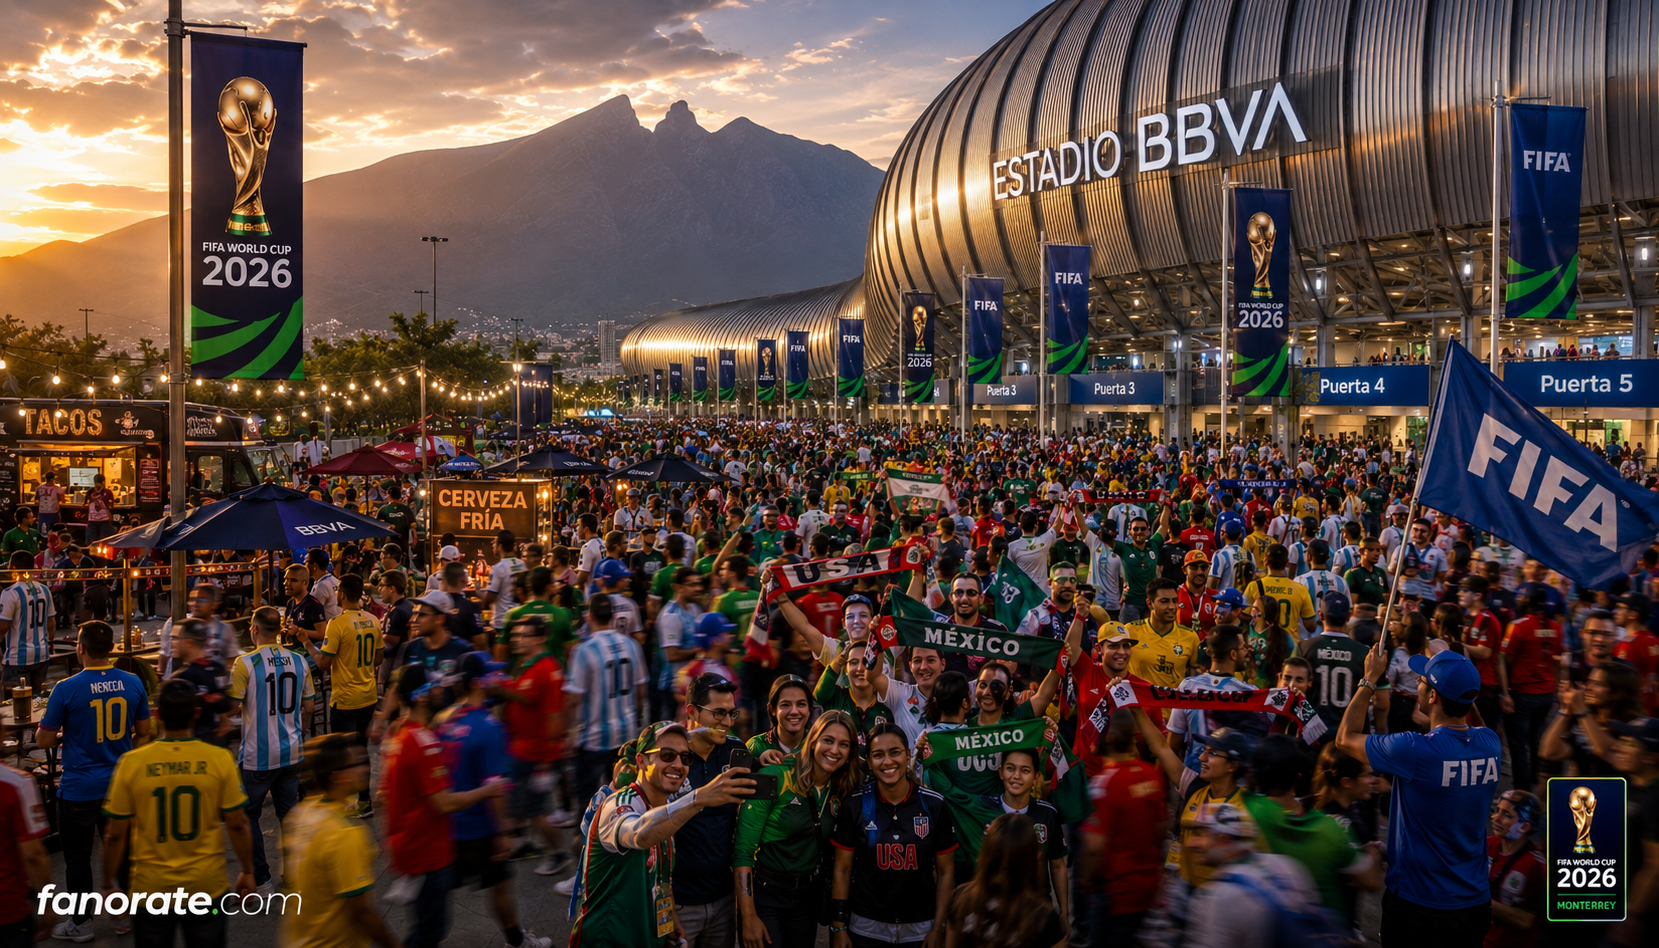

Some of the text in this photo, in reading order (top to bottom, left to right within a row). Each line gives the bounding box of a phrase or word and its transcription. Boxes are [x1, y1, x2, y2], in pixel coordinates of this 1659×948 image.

[992, 82, 1311, 200] ESTADIO BBVA
[1523, 150, 1571, 172] FIFA
[203, 242, 292, 255] FIFA WORLD CUP
[202, 255, 293, 289] 2026
[1055, 272, 1083, 285] FIFA
[974, 300, 998, 311] FIFA
[1238, 310, 1284, 328] 2026
[843, 335, 860, 343] FIFA
[907, 358, 932, 367] 2026
[1010, 385, 1017, 396] 3
[1094, 382, 1135, 395] Puerta 3
[1320, 377, 1385, 393] Puerta 4
[1541, 374, 1633, 393] Puerta 5
[23, 408, 103, 436] TACOS
[1467, 413, 1618, 552] FIFA
[438, 489, 528, 509] CERVEZA
[294, 521, 356, 536] BBVA
[460, 508, 505, 530] FRÍA
[796, 552, 880, 584] USA
[29, 598, 46, 629] 10
[356, 632, 375, 668] 10
[924, 626, 1020, 657] MÉXICO
[265, 671, 298, 716] 10
[1315, 664, 1353, 707] 10
[90, 696, 127, 743] 10
[955, 728, 1024, 750] MÉXICO
[146, 761, 191, 777] NEYMAR
[1441, 757, 1498, 787] FIFA
[152, 785, 202, 845] 10
[876, 843, 918, 871] USA
